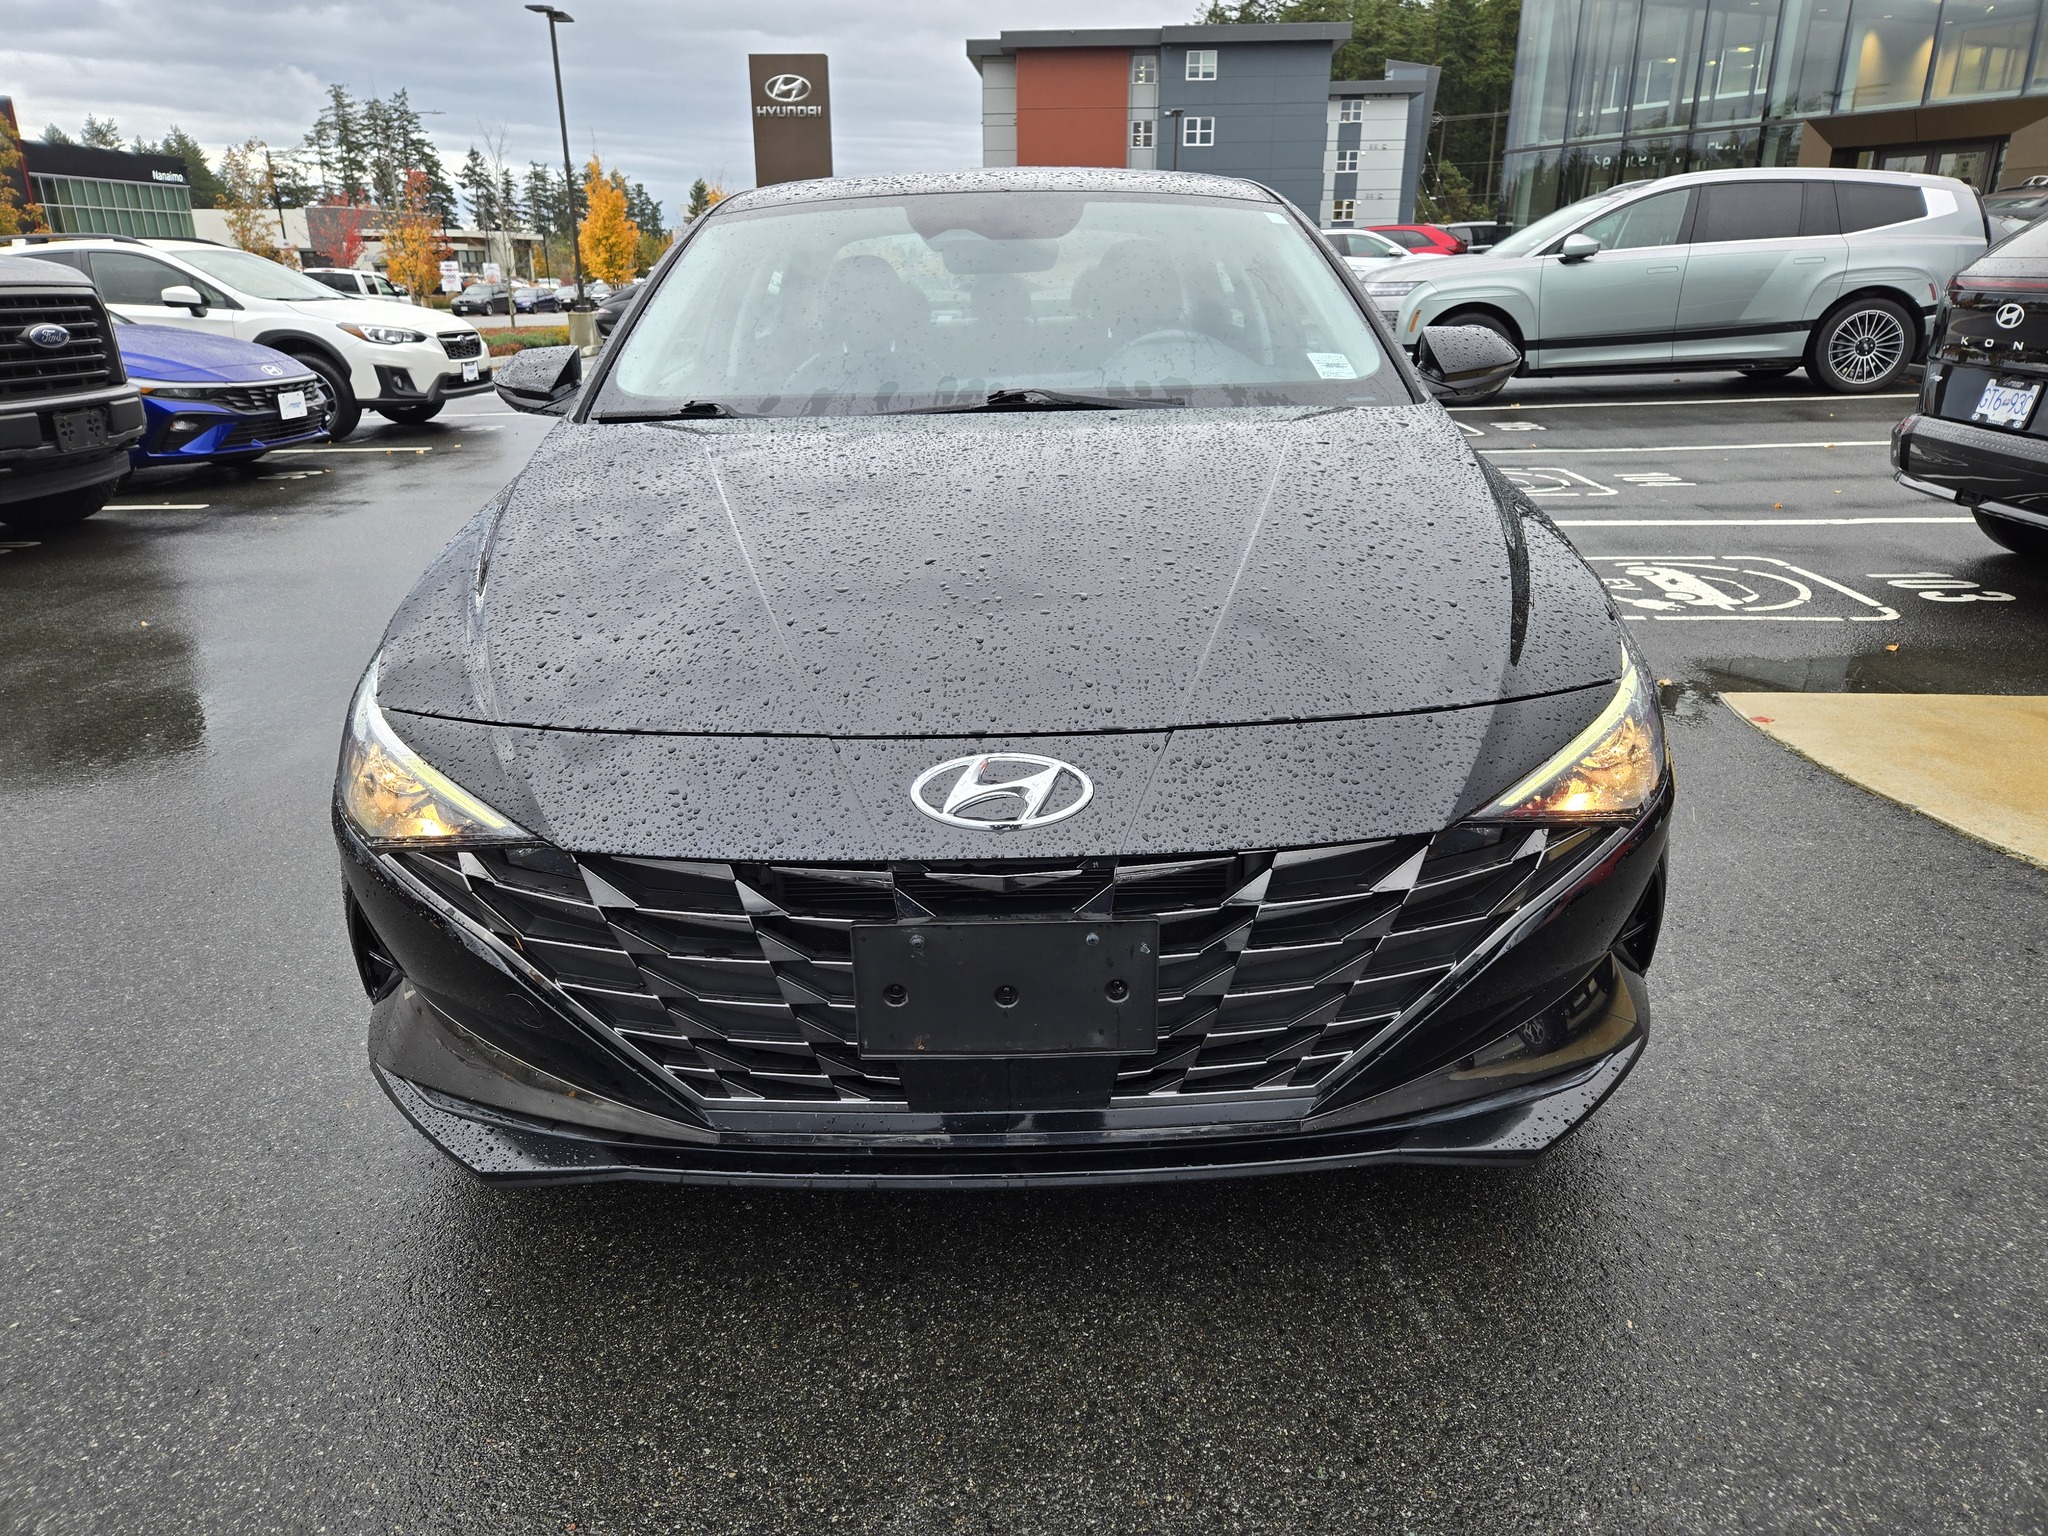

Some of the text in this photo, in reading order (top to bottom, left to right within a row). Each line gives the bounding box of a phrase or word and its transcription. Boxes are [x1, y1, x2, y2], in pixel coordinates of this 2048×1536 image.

[756, 105, 822, 117] HYUNDAI
[152, 169, 184, 183] Nanaimo
[41, 329, 62, 343] Ford
[1960, 336, 2048, 354] KON
[1865, 571, 2017, 602] 103
